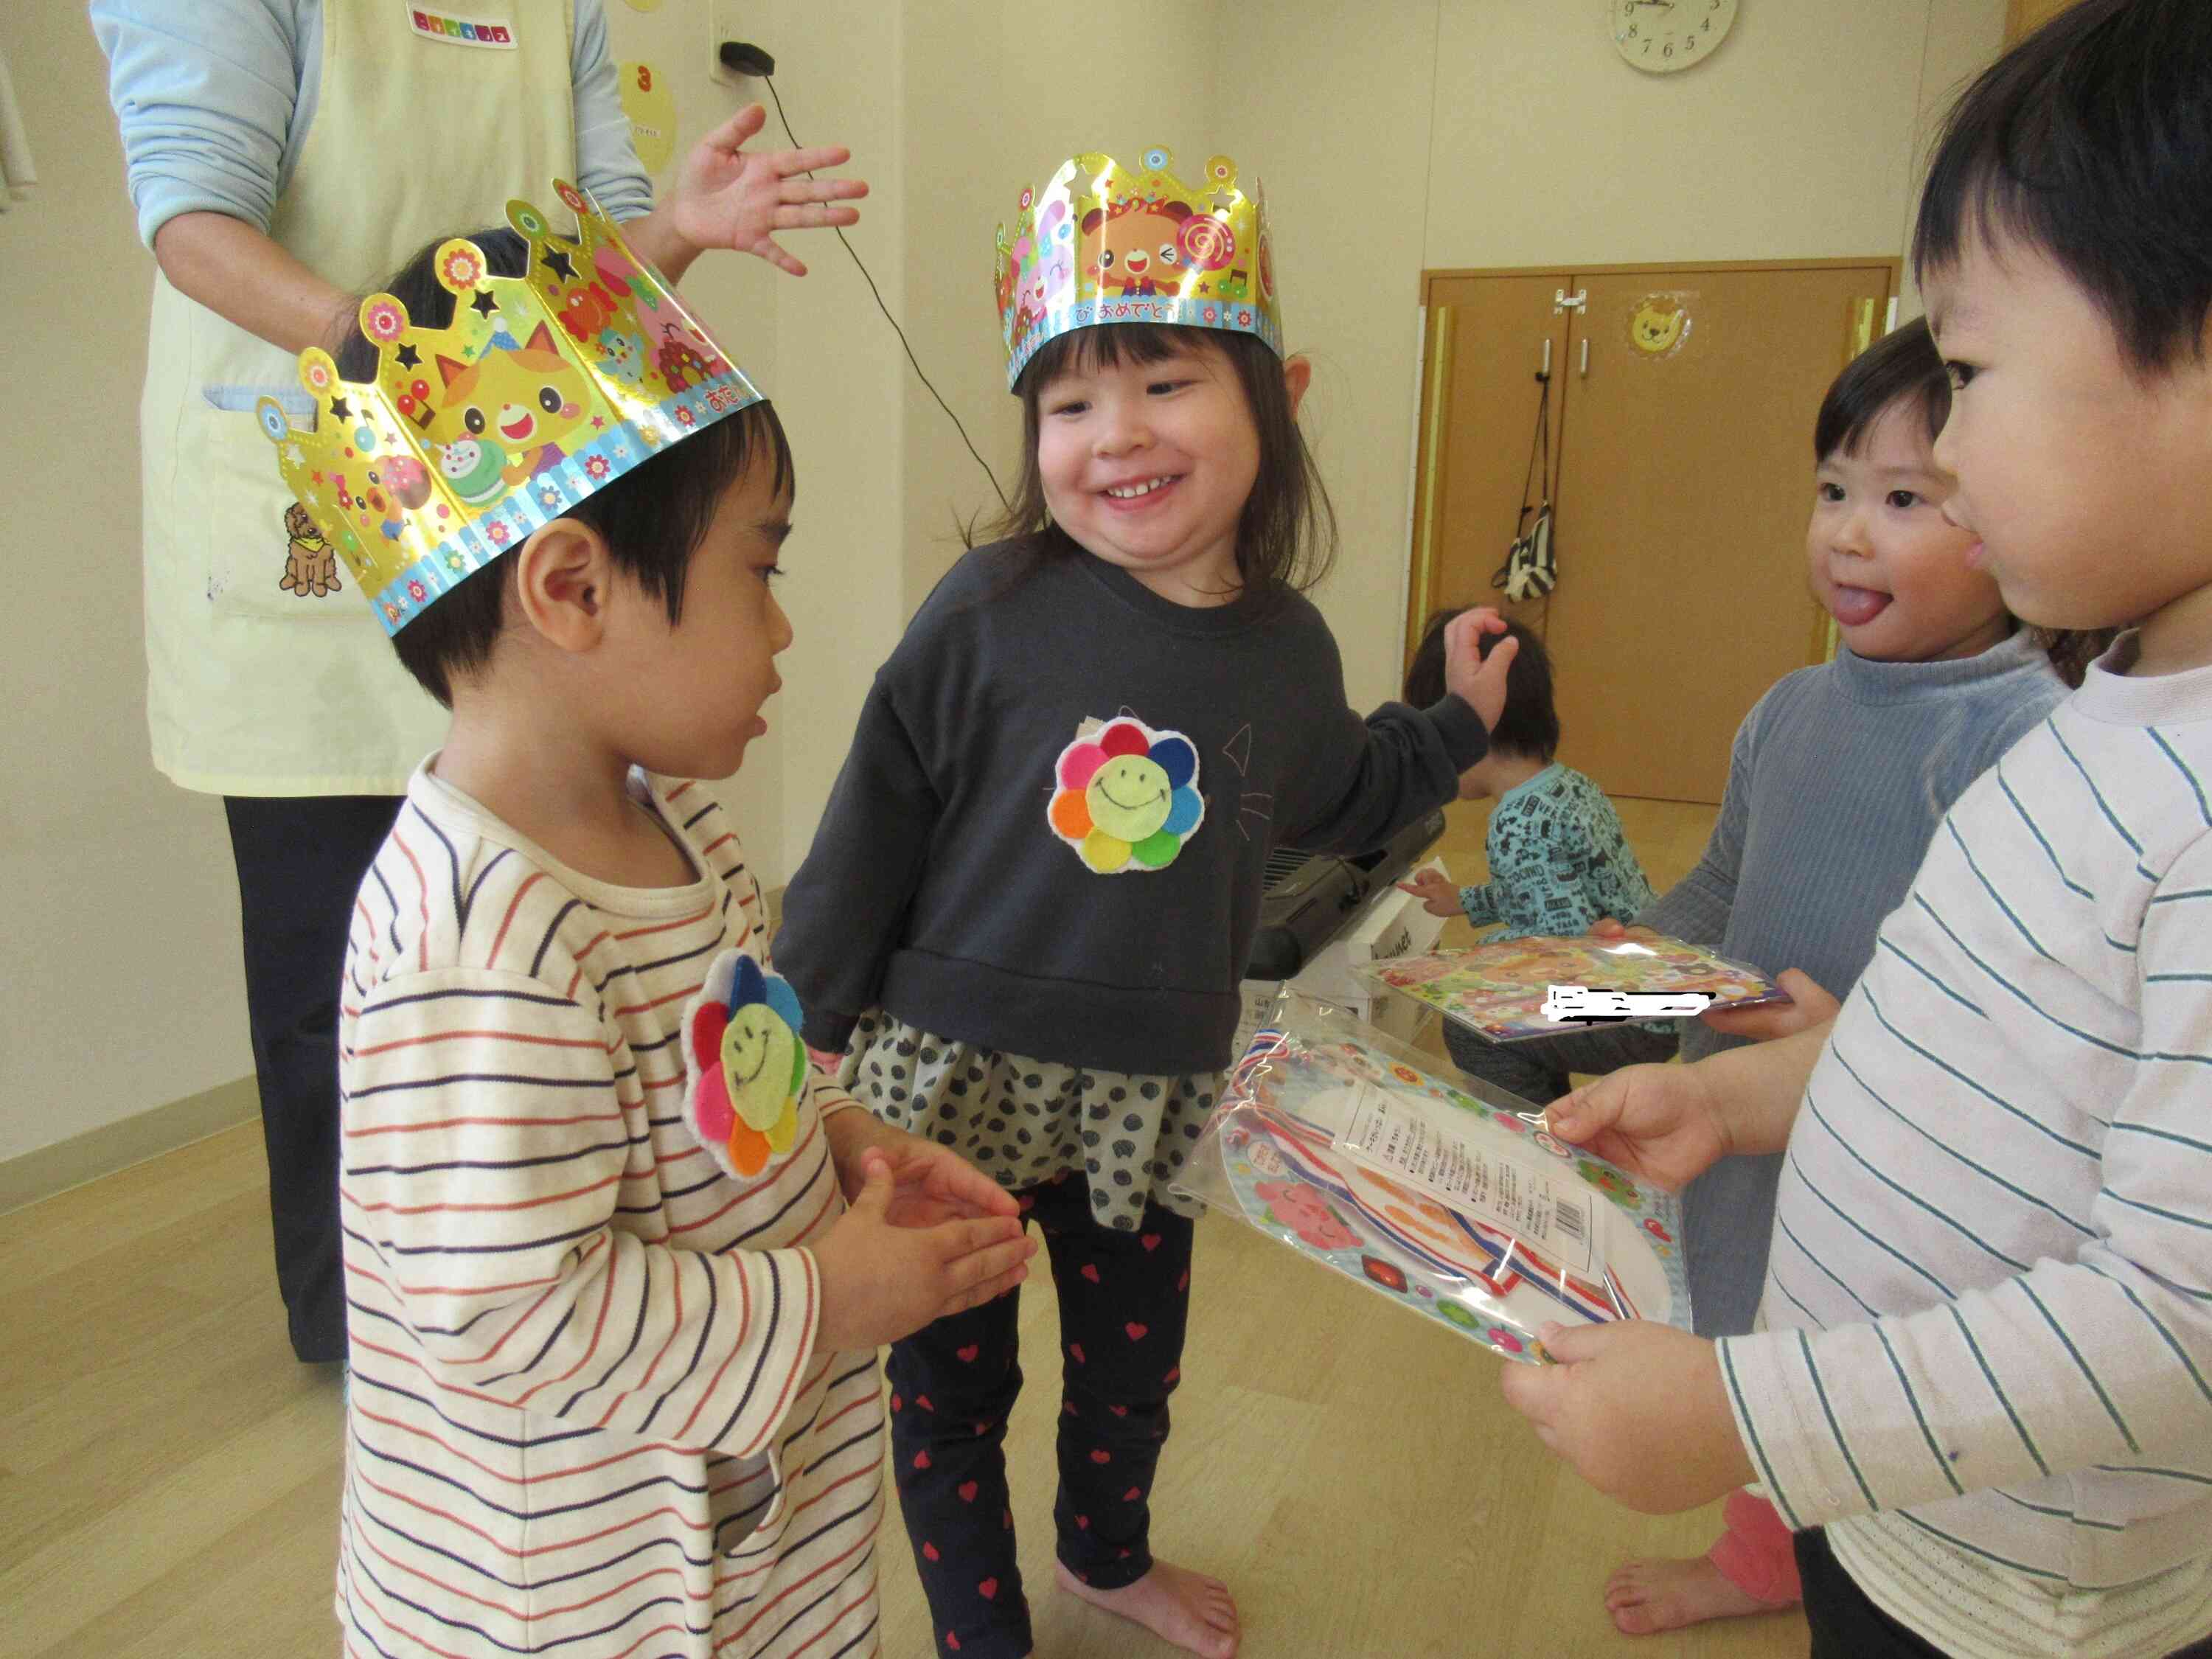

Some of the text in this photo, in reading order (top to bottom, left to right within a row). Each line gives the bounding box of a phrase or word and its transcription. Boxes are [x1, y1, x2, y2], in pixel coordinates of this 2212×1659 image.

[1624, 1, 1635, 16] 9
[1628, 24, 1638, 38] 8
[1700, 17, 1710, 31] 4
[1642, 38, 1652, 54] 7
[1663, 42, 1673, 58] 6
[1684, 35, 1694, 50] 5
[637, 65, 651, 92] 3
